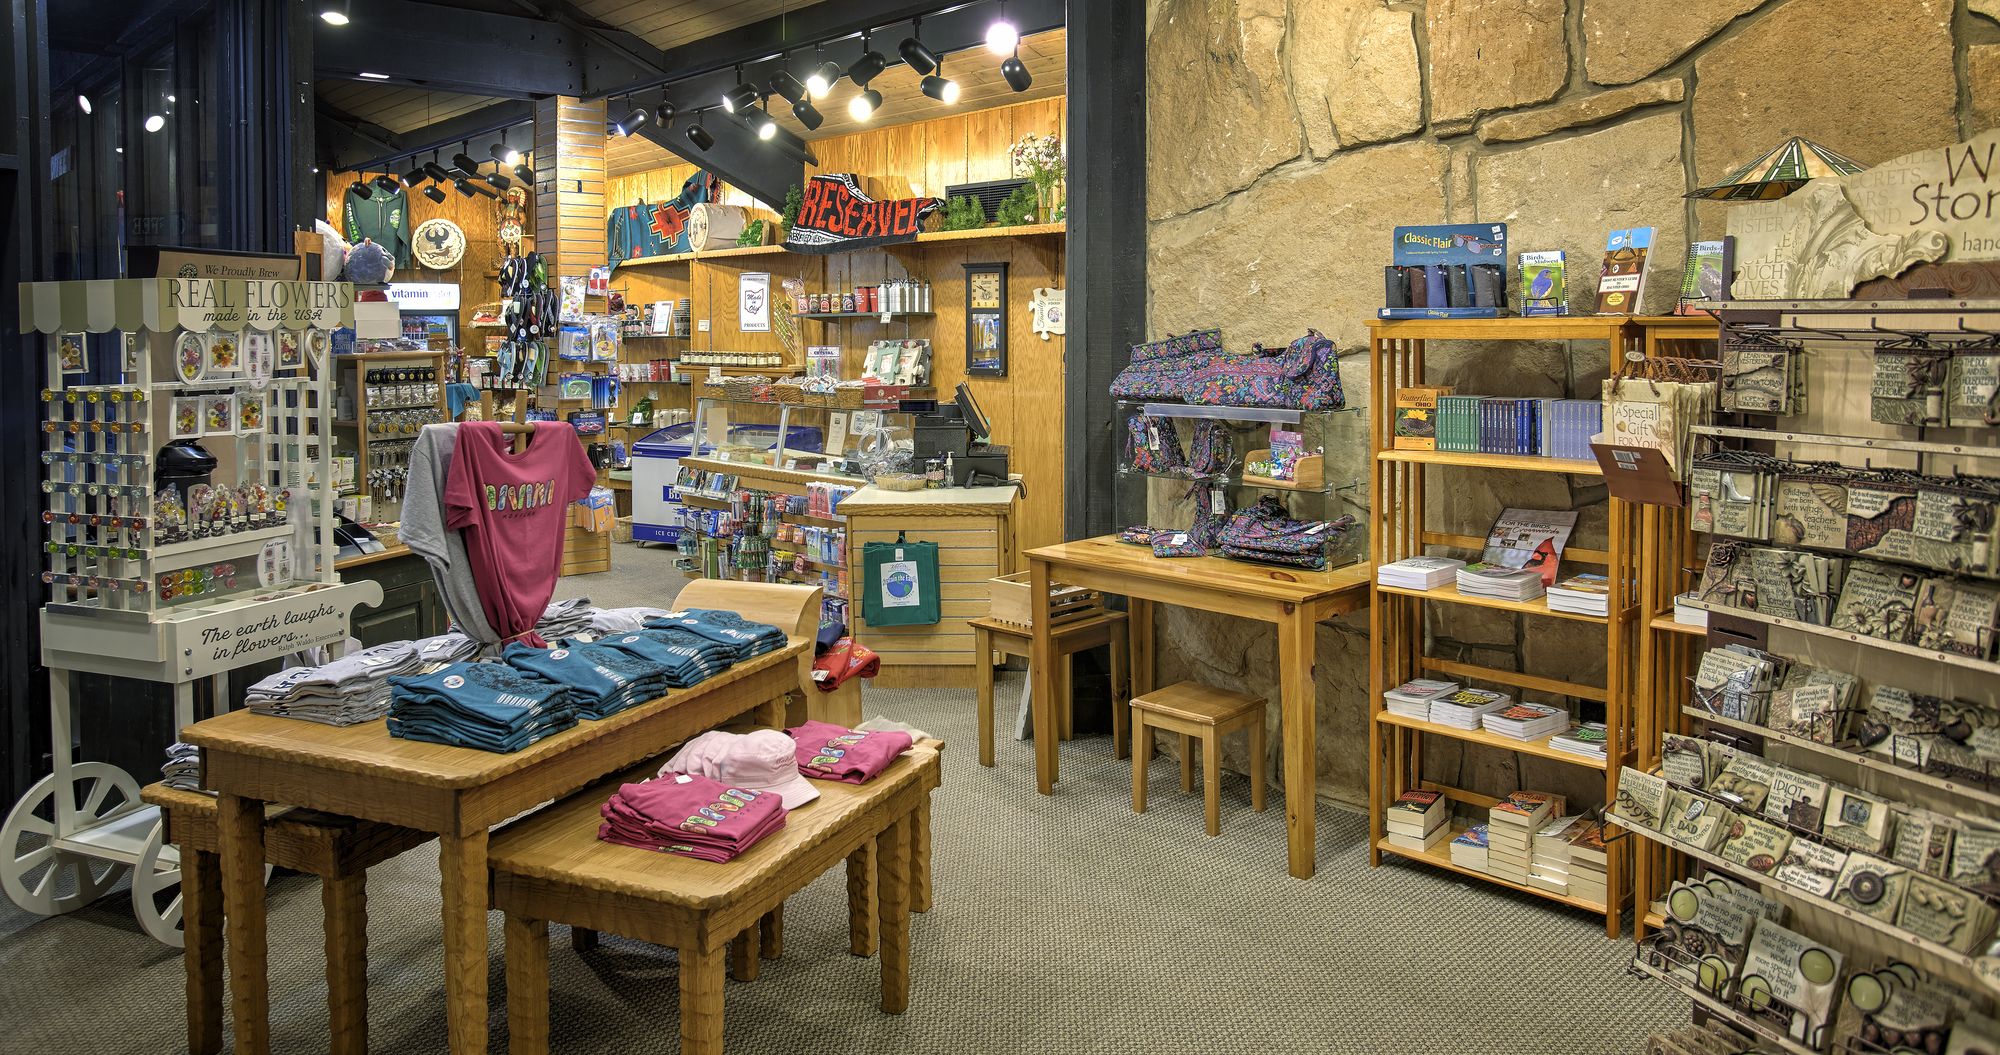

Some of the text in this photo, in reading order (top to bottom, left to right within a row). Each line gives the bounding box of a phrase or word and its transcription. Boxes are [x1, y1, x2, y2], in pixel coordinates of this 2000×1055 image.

[1944, 142, 1997, 187] W
[1909, 181, 2000, 226] Stor
[1404, 232, 1453, 249] Classic Flair
[205, 264, 221, 275] We
[221, 265, 257, 278] Proudly
[259, 267, 280, 278] Brew
[167, 279, 350, 310] REAL FLOWERS
[391, 288, 429, 299] vitamin
[203, 308, 322, 323] made in the USA
[1399, 393, 1434, 402] Butterflies
[1615, 405, 1658, 421] A Special
[1627, 420, 1651, 436] Gift
[1618, 437, 1634, 446] FOR
[1783, 488, 1810, 497] Children
[1530, 522, 1552, 530] BIRDS
[1803, 515, 1837, 524] teachers
[1807, 523, 1821, 532] help
[1512, 526, 1560, 534] Crosswords
[1818, 532, 1829, 543] fly
[202, 602, 336, 645] The earth laughs
[212, 632, 309, 661] in flowers...
[278, 631, 339, 652] Ralph Waldo Emerson
[1704, 673, 1721, 684] Daddy
[1626, 771, 1639, 781] know
[1652, 780, 1663, 789] not
[1782, 772, 1795, 781] NOT
[1797, 777, 1821, 791] COMPLETE
[1773, 779, 1806, 798] IDIOT
[1619, 791, 1653, 827] 99.9%
[1677, 820, 1699, 835] DAD
[1693, 823, 1712, 841] CONTROL
[1762, 825, 1786, 839] nothing
[1753, 830, 1774, 842] wrong
[1795, 839, 1811, 849] There's
[1818, 847, 1835, 857] friend
[1736, 853, 1744, 864] fix
[1817, 855, 1836, 866] Sister
[1790, 869, 1800, 877] and
[1796, 878, 1809, 887] than
[1716, 894, 1731, 904] There
[1736, 904, 1747, 912] no
[1747, 908, 1760, 918] gift
[1734, 888, 1749, 899] There
[1754, 899, 1764, 907] no
[1765, 903, 1778, 913] gift
[1700, 897, 1715, 910] There
[1720, 908, 1730, 917] no
[1730, 913, 1743, 923] gift
[1704, 910, 1732, 928] precious
[1699, 918, 1735, 939] true friend
[1760, 927, 1803, 952] SOME PEOPLE
[1760, 939, 1786, 955] make the
[1770, 951, 1792, 967] world
[1755, 956, 1796, 979] more special
[1756, 967, 1797, 994] just by being
[1773, 985, 1790, 999] in it
